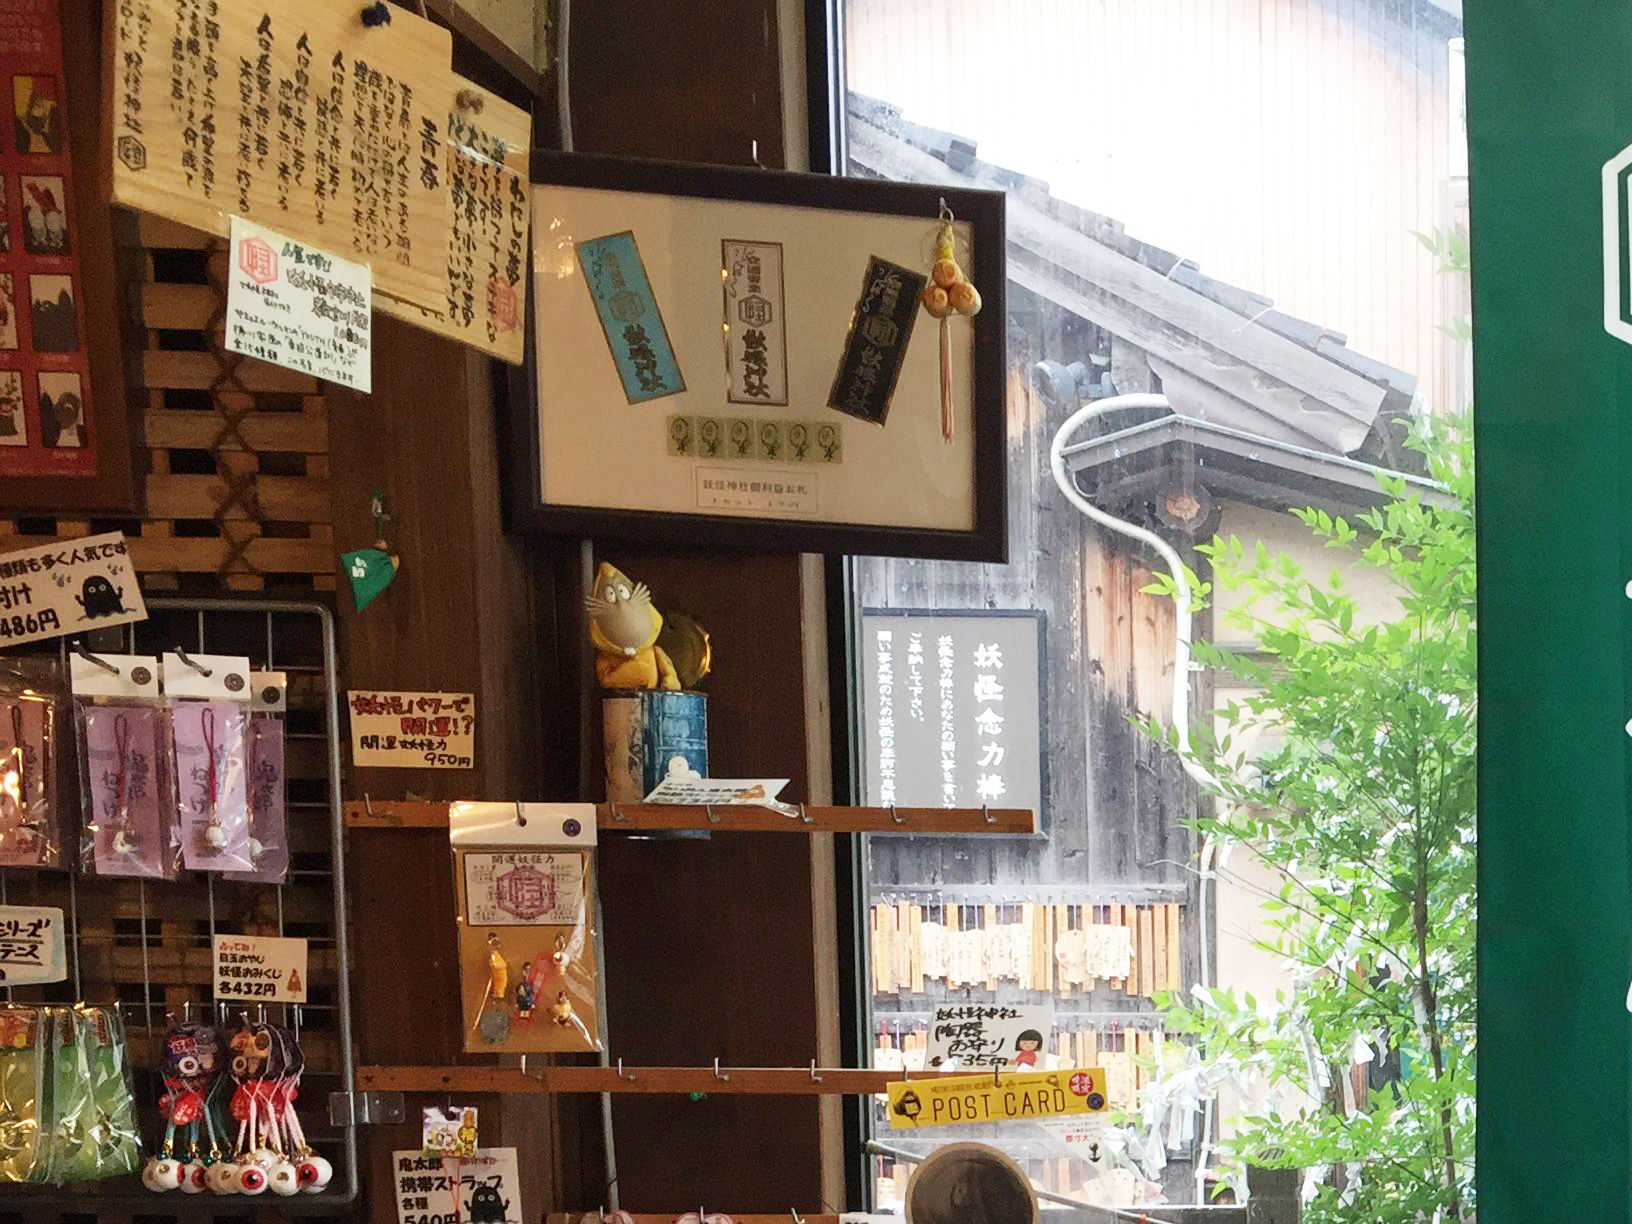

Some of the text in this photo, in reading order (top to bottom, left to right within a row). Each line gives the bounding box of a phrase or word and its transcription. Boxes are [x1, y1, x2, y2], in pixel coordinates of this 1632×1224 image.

[420, 115, 441, 191] 青春
[0, 608, 61, 638] 486円
[351, 694, 470, 716] 妖怪パワーで
[973, 642, 1006, 801] 妖怪念力棒
[360, 735, 447, 751] 開運妖怪力
[424, 752, 471, 767] 950円
[219, 952, 265, 965] 目玉おやじ
[219, 965, 283, 980] 妖怪おみくじ
[219, 981, 276, 997] 各432円
[936, 1006, 1023, 1022] 妖怪神社
[948, 1037, 1005, 1056] お守り
[932, 1087, 1067, 1123] POST CARD
[398, 1156, 444, 1172] 鬼太郎
[400, 1175, 504, 1193] 携帯ストラップ
[401, 1197, 429, 1211] 各種
